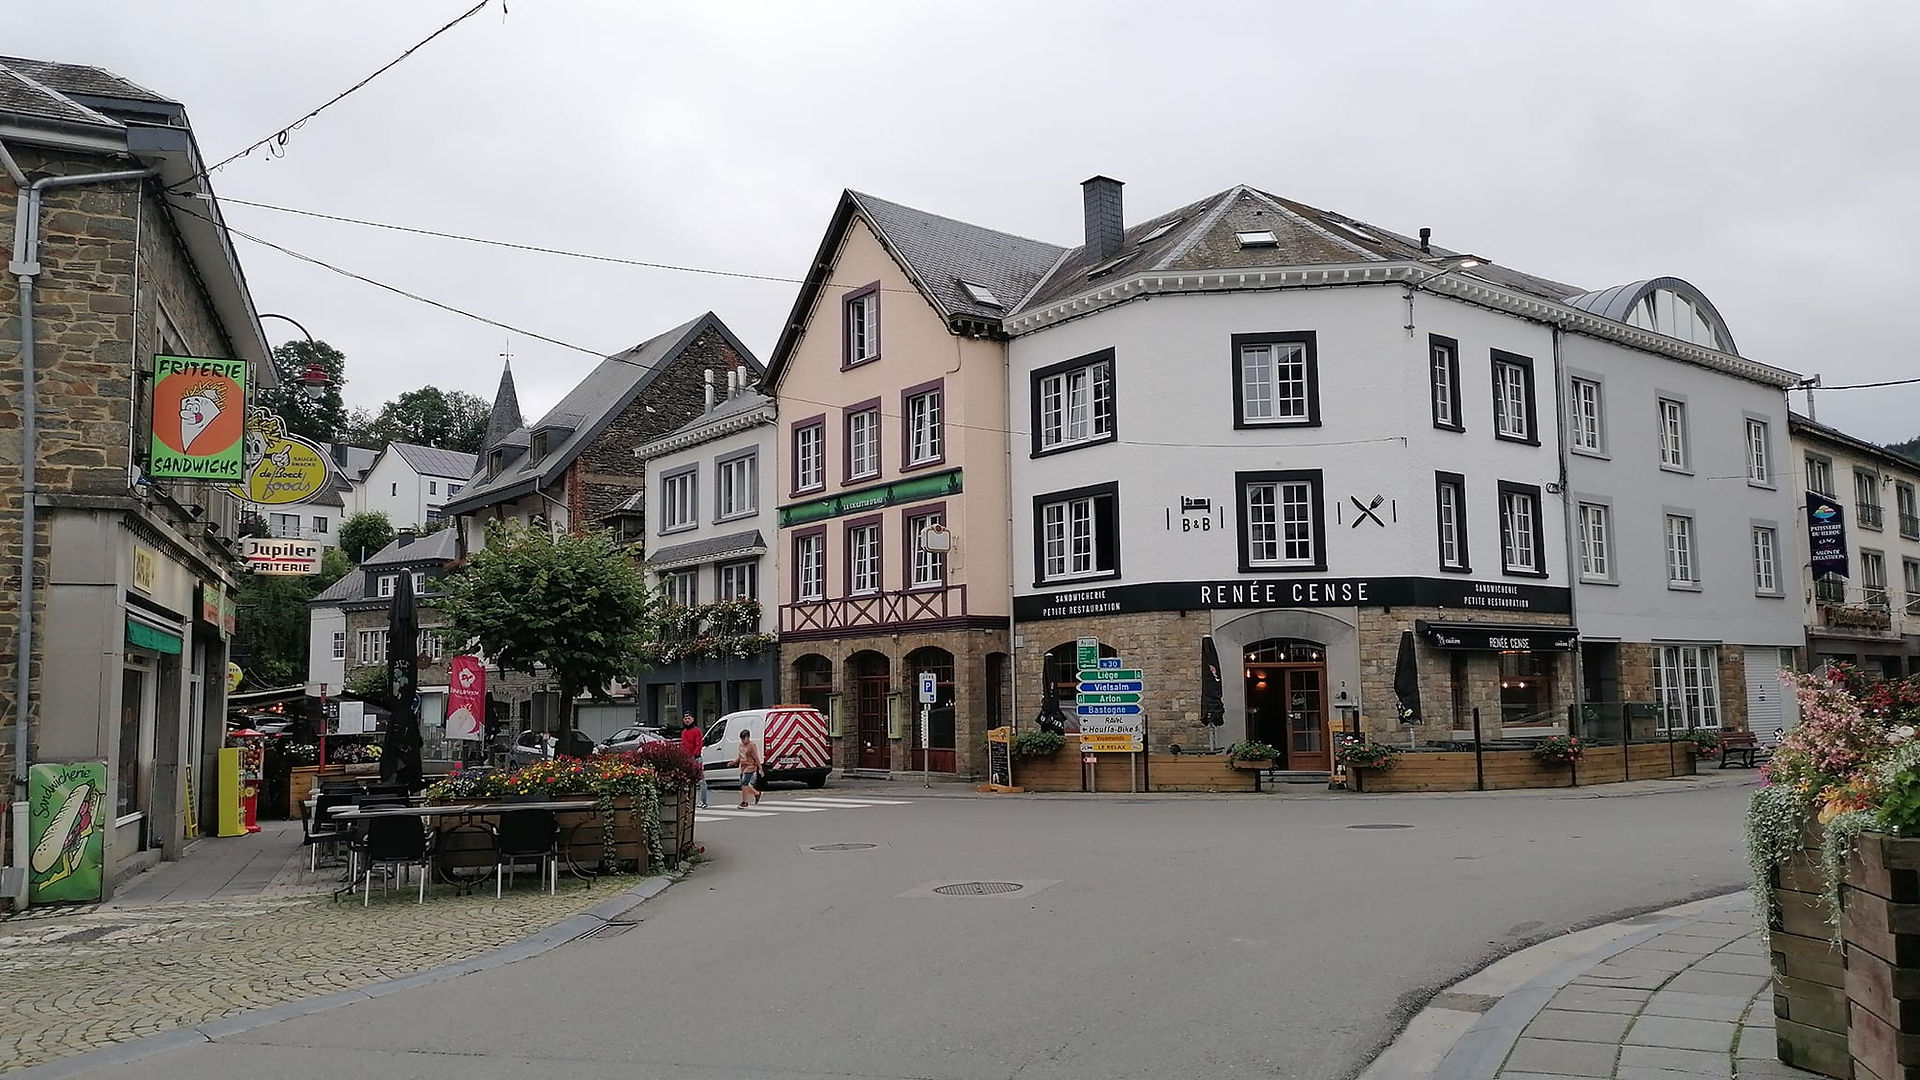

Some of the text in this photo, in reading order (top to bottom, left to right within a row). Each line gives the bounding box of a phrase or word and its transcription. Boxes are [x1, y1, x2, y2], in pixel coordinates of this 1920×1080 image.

[158, 360, 242, 379] FRITERIE
[154, 457, 239, 475] SANDWICHS
[262, 468, 311, 500] foods
[1182, 517, 1211, 532] B&B
[250, 542, 317, 558] Jupiler
[253, 563, 310, 572] FRITERIE
[1201, 580, 1368, 603] RENÉE CENSE
[1475, 583, 1518, 595] SANDWICHERIE
[1055, 590, 1106, 603] SANDWICHERIE
[1464, 596, 1529, 608] PETITE RESTAURATION
[1042, 602, 1121, 617] PETITE RESTAURATION
[1489, 635, 1530, 649] RENÉE CENSE
[1097, 671, 1119, 681] Liège
[925, 682, 931, 691] P
[1095, 683, 1129, 691] Vielsalm
[1088, 706, 1126, 715] Bastogne
[33, 765, 91, 819] Sandwicherie
